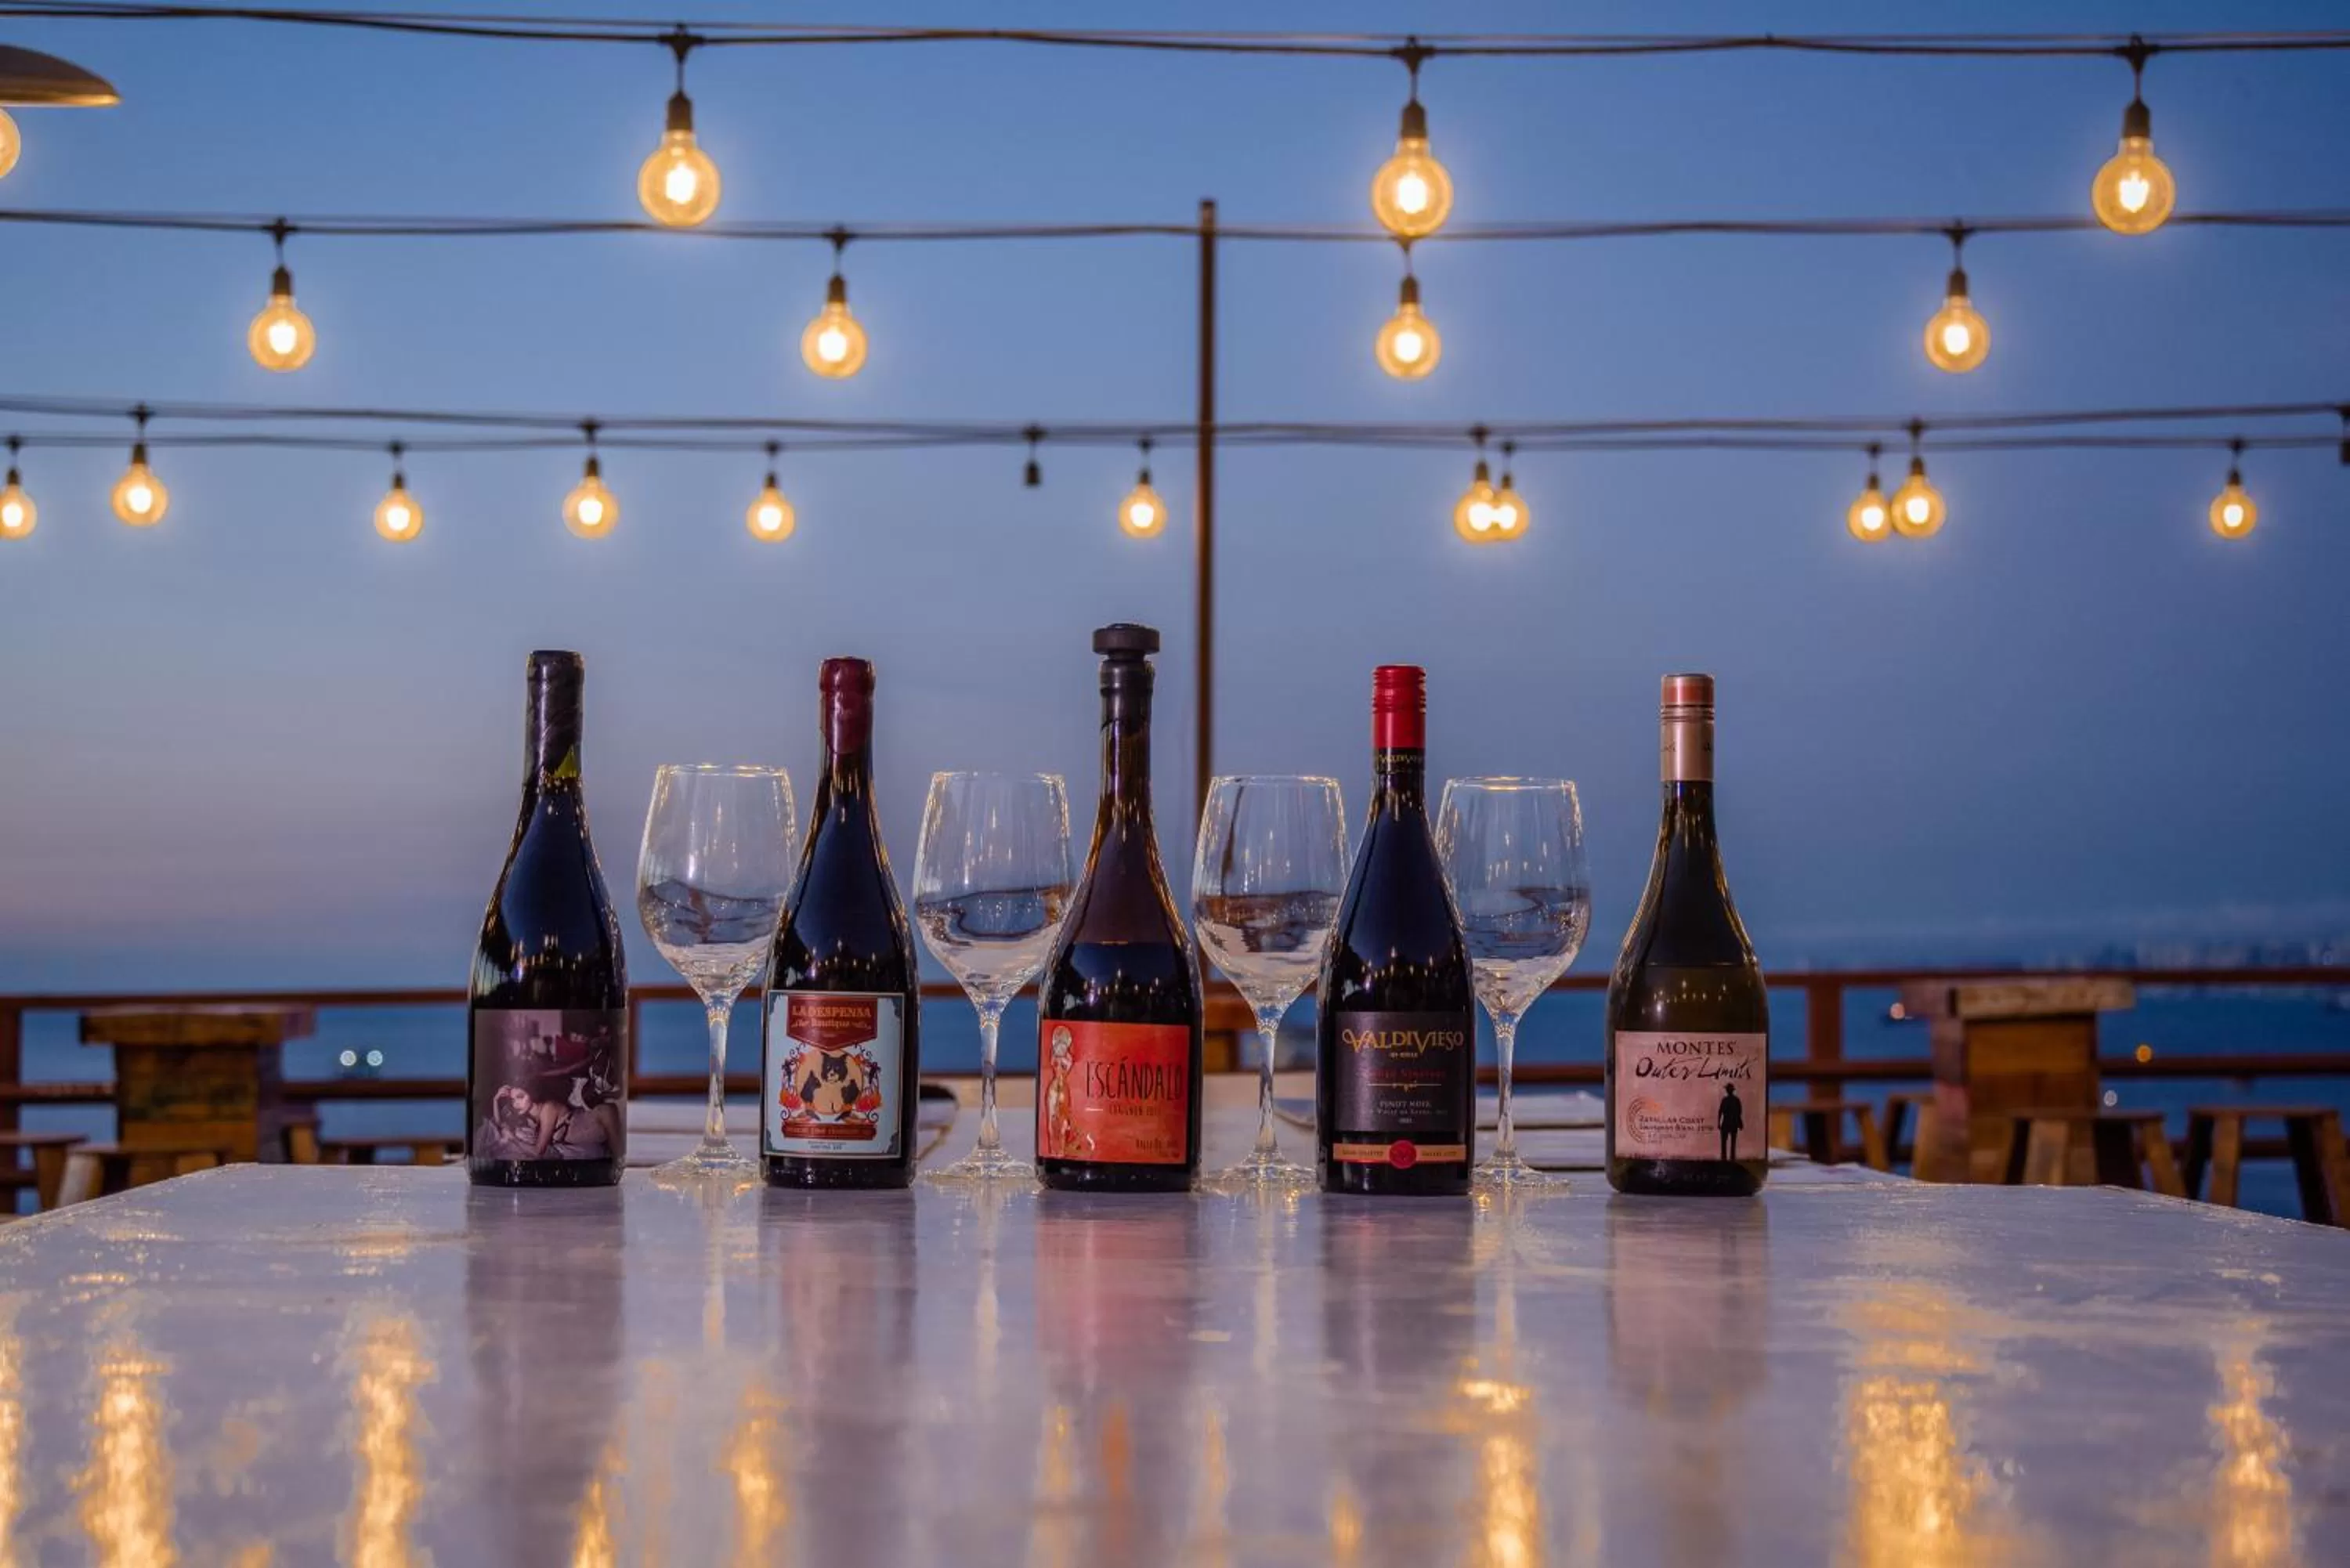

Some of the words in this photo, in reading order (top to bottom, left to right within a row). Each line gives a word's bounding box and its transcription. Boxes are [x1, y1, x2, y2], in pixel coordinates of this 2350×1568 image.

[791, 1005, 807, 1016] LA
[808, 1006, 872, 1017] DESPENSA
[1342, 1028, 1464, 1053] VALDIVIESO
[1635, 1056, 1701, 1081] Outer
